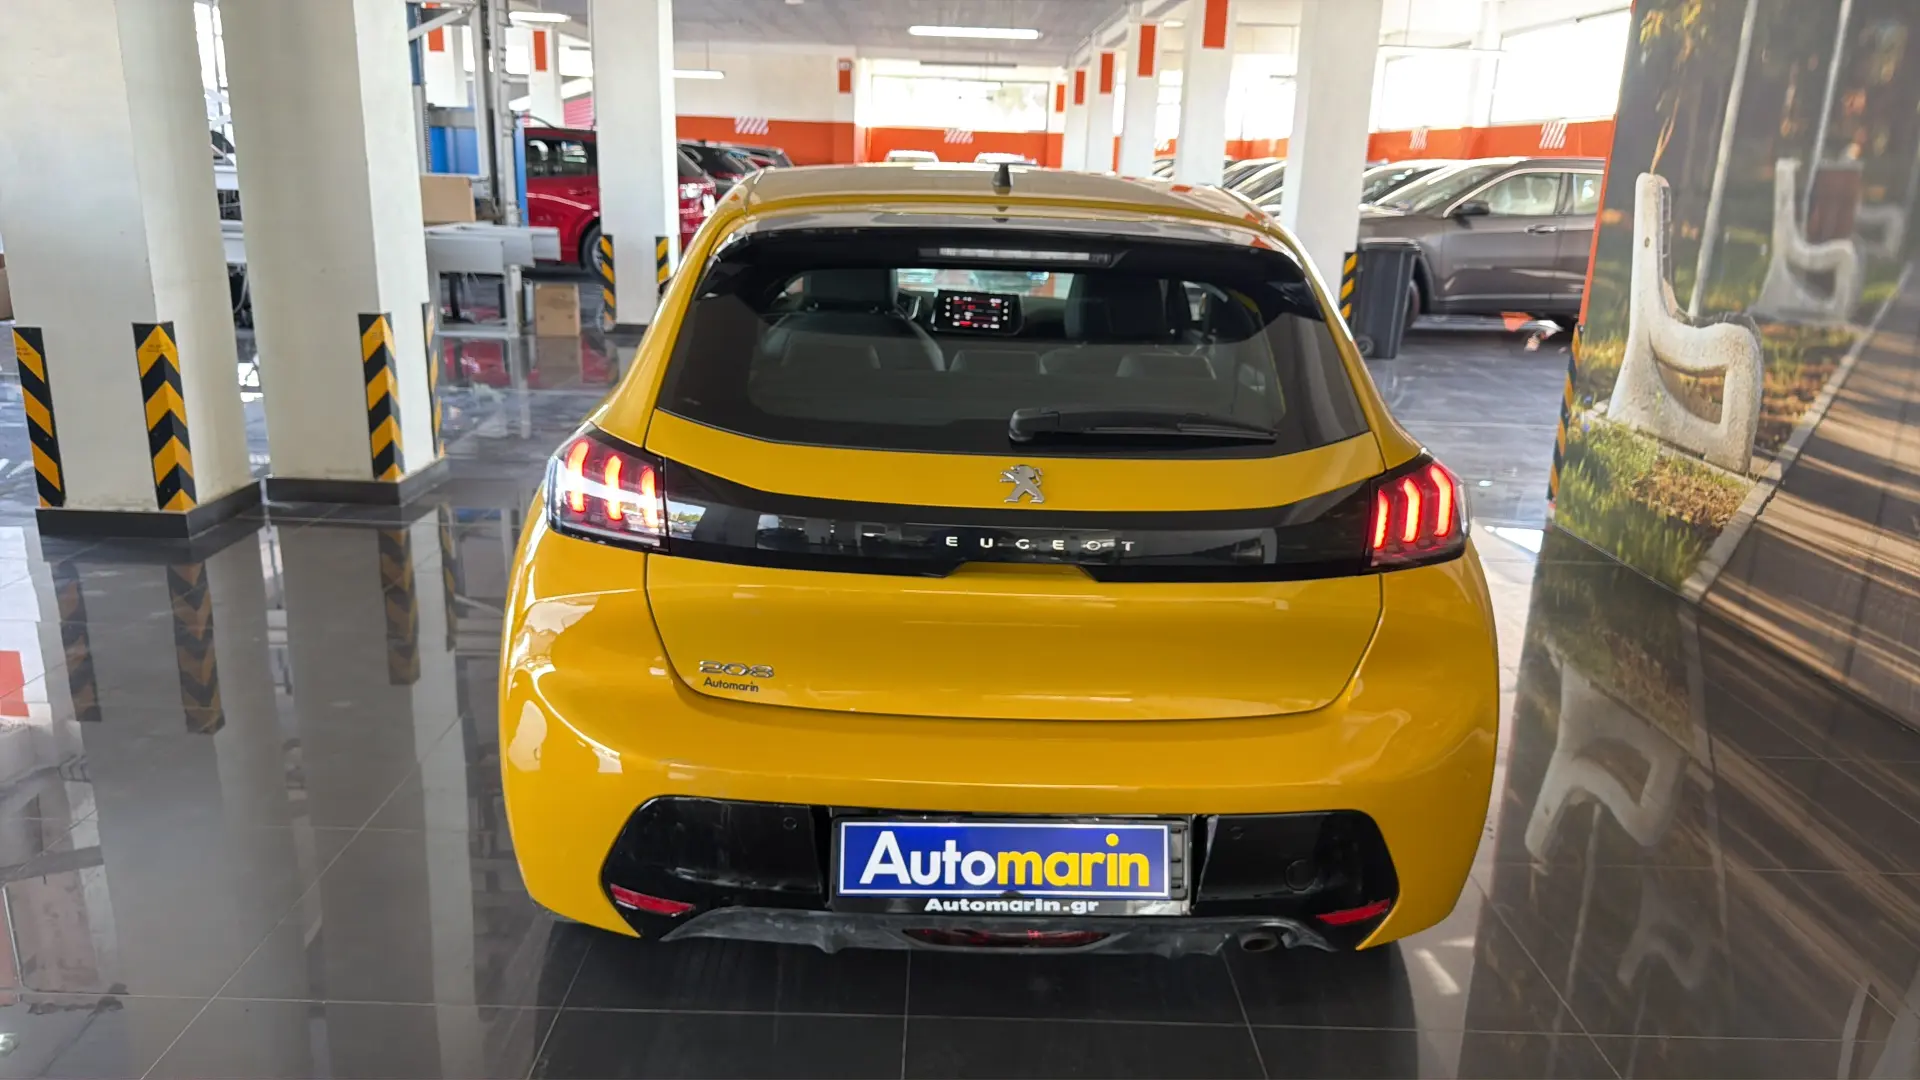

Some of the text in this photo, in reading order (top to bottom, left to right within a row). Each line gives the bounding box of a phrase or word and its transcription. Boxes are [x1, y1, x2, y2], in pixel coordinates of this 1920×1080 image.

[699, 660, 774, 678] 208
[703, 676, 759, 692] Automarin
[858, 830, 1150, 886] Automarin
[924, 897, 1099, 914] Automarin.gr
